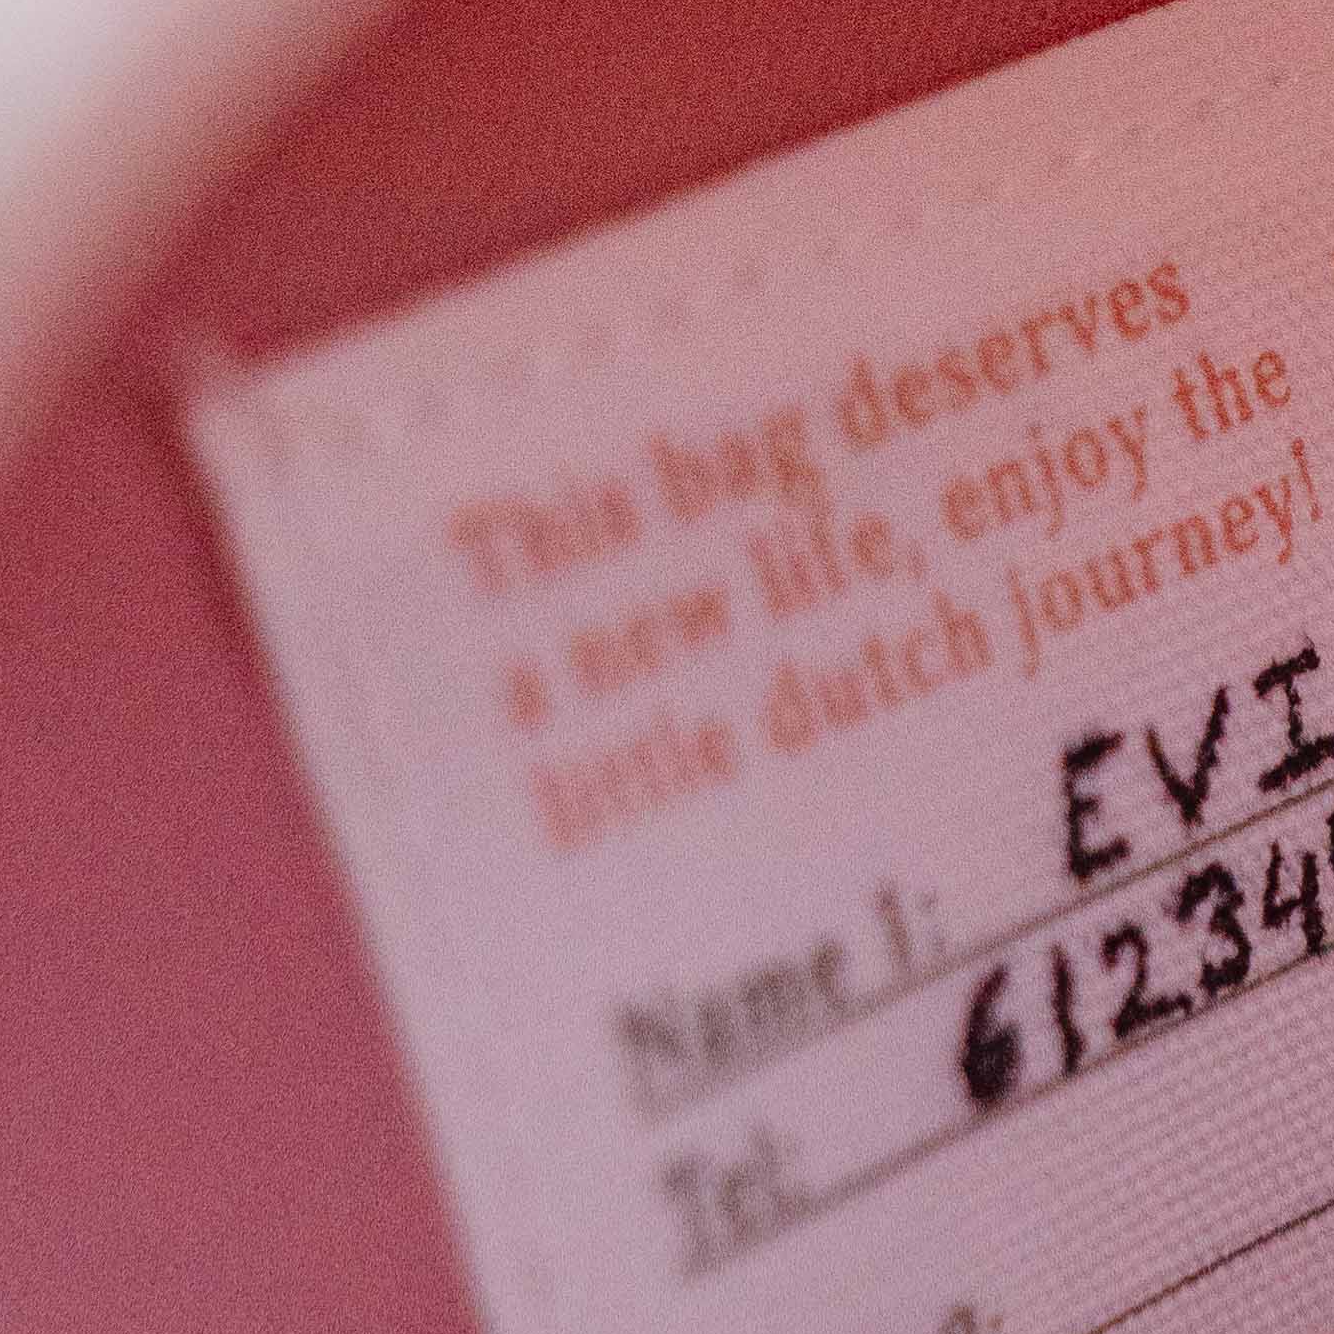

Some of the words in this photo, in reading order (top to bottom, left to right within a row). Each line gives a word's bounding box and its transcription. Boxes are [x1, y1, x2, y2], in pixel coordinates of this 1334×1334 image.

[450, 467, 644, 594] This
[650, 405, 830, 524] bag
[838, 261, 1190, 451] deserves
[570, 584, 728, 697] new
[747, 502, 929, 620] life,
[940, 403, 1156, 541] enjoy
[1171, 345, 1293, 440] the
[532, 717, 737, 852] little
[762, 583, 993, 757] dutch
[1011, 437, 1323, 677] journey!
[618, 933, 864, 1123] Name
